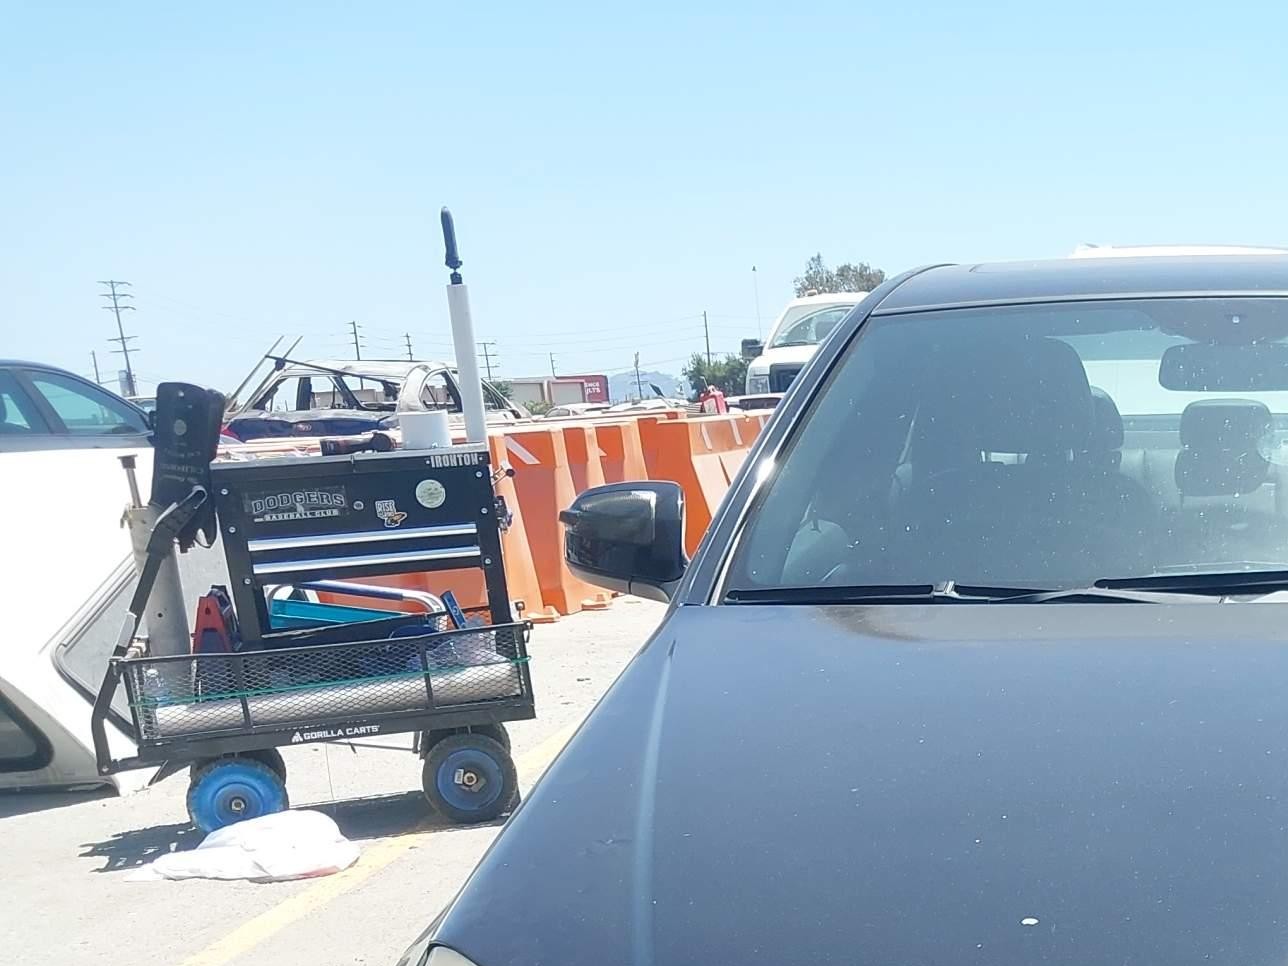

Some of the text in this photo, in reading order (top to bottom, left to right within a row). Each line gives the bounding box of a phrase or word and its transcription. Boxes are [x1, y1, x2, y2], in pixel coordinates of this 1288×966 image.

[430, 453, 479, 468] IRONTON
[252, 491, 345, 514] DODGERS
[303, 725, 379, 740] GORILLA CARTS
